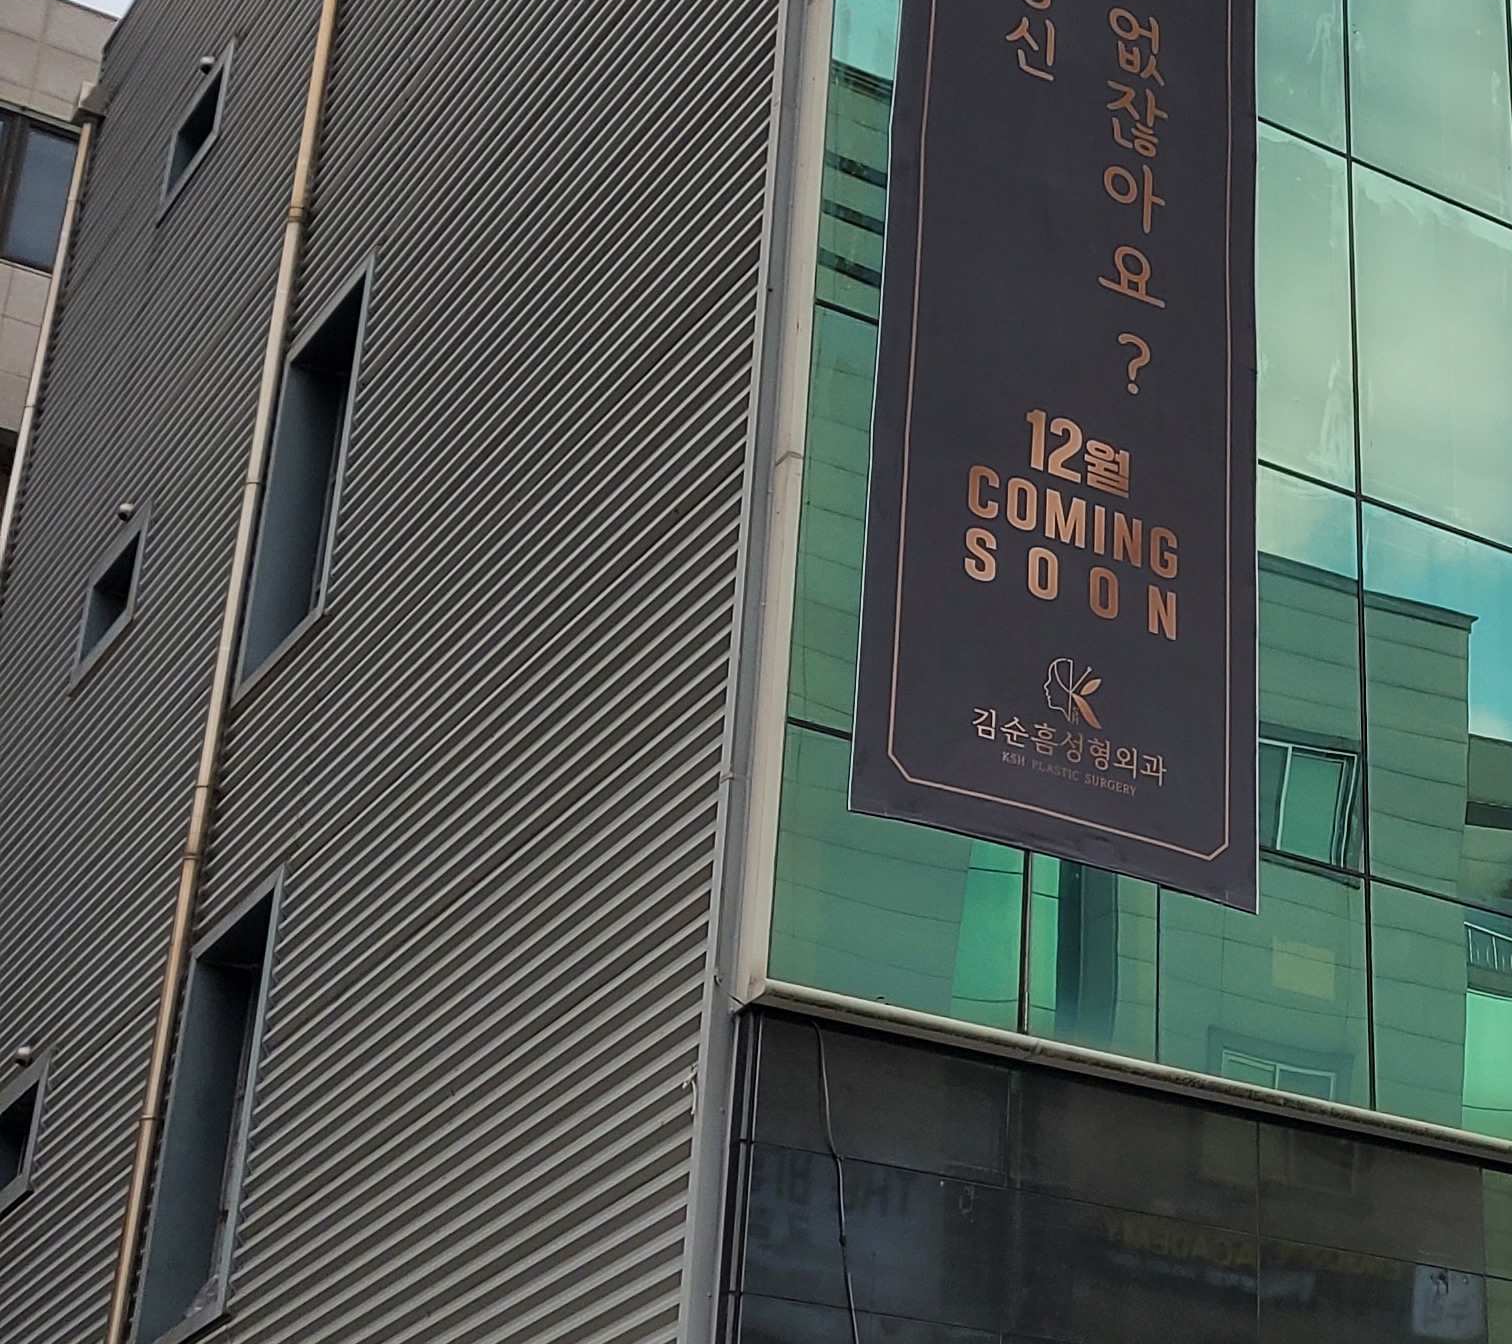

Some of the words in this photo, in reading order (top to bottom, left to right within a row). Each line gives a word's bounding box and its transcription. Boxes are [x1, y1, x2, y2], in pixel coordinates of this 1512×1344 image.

[1026, 408, 1130, 499] 12월
[968, 465, 1179, 578] COMING
[964, 526, 1177, 641] SOON
[971, 707, 1167, 787] 김순흠성형외과
[1002, 751, 1025, 767] KSH
[1032, 759, 1079, 781] PLASTIC
[1084, 774, 1136, 796] SURGERY
